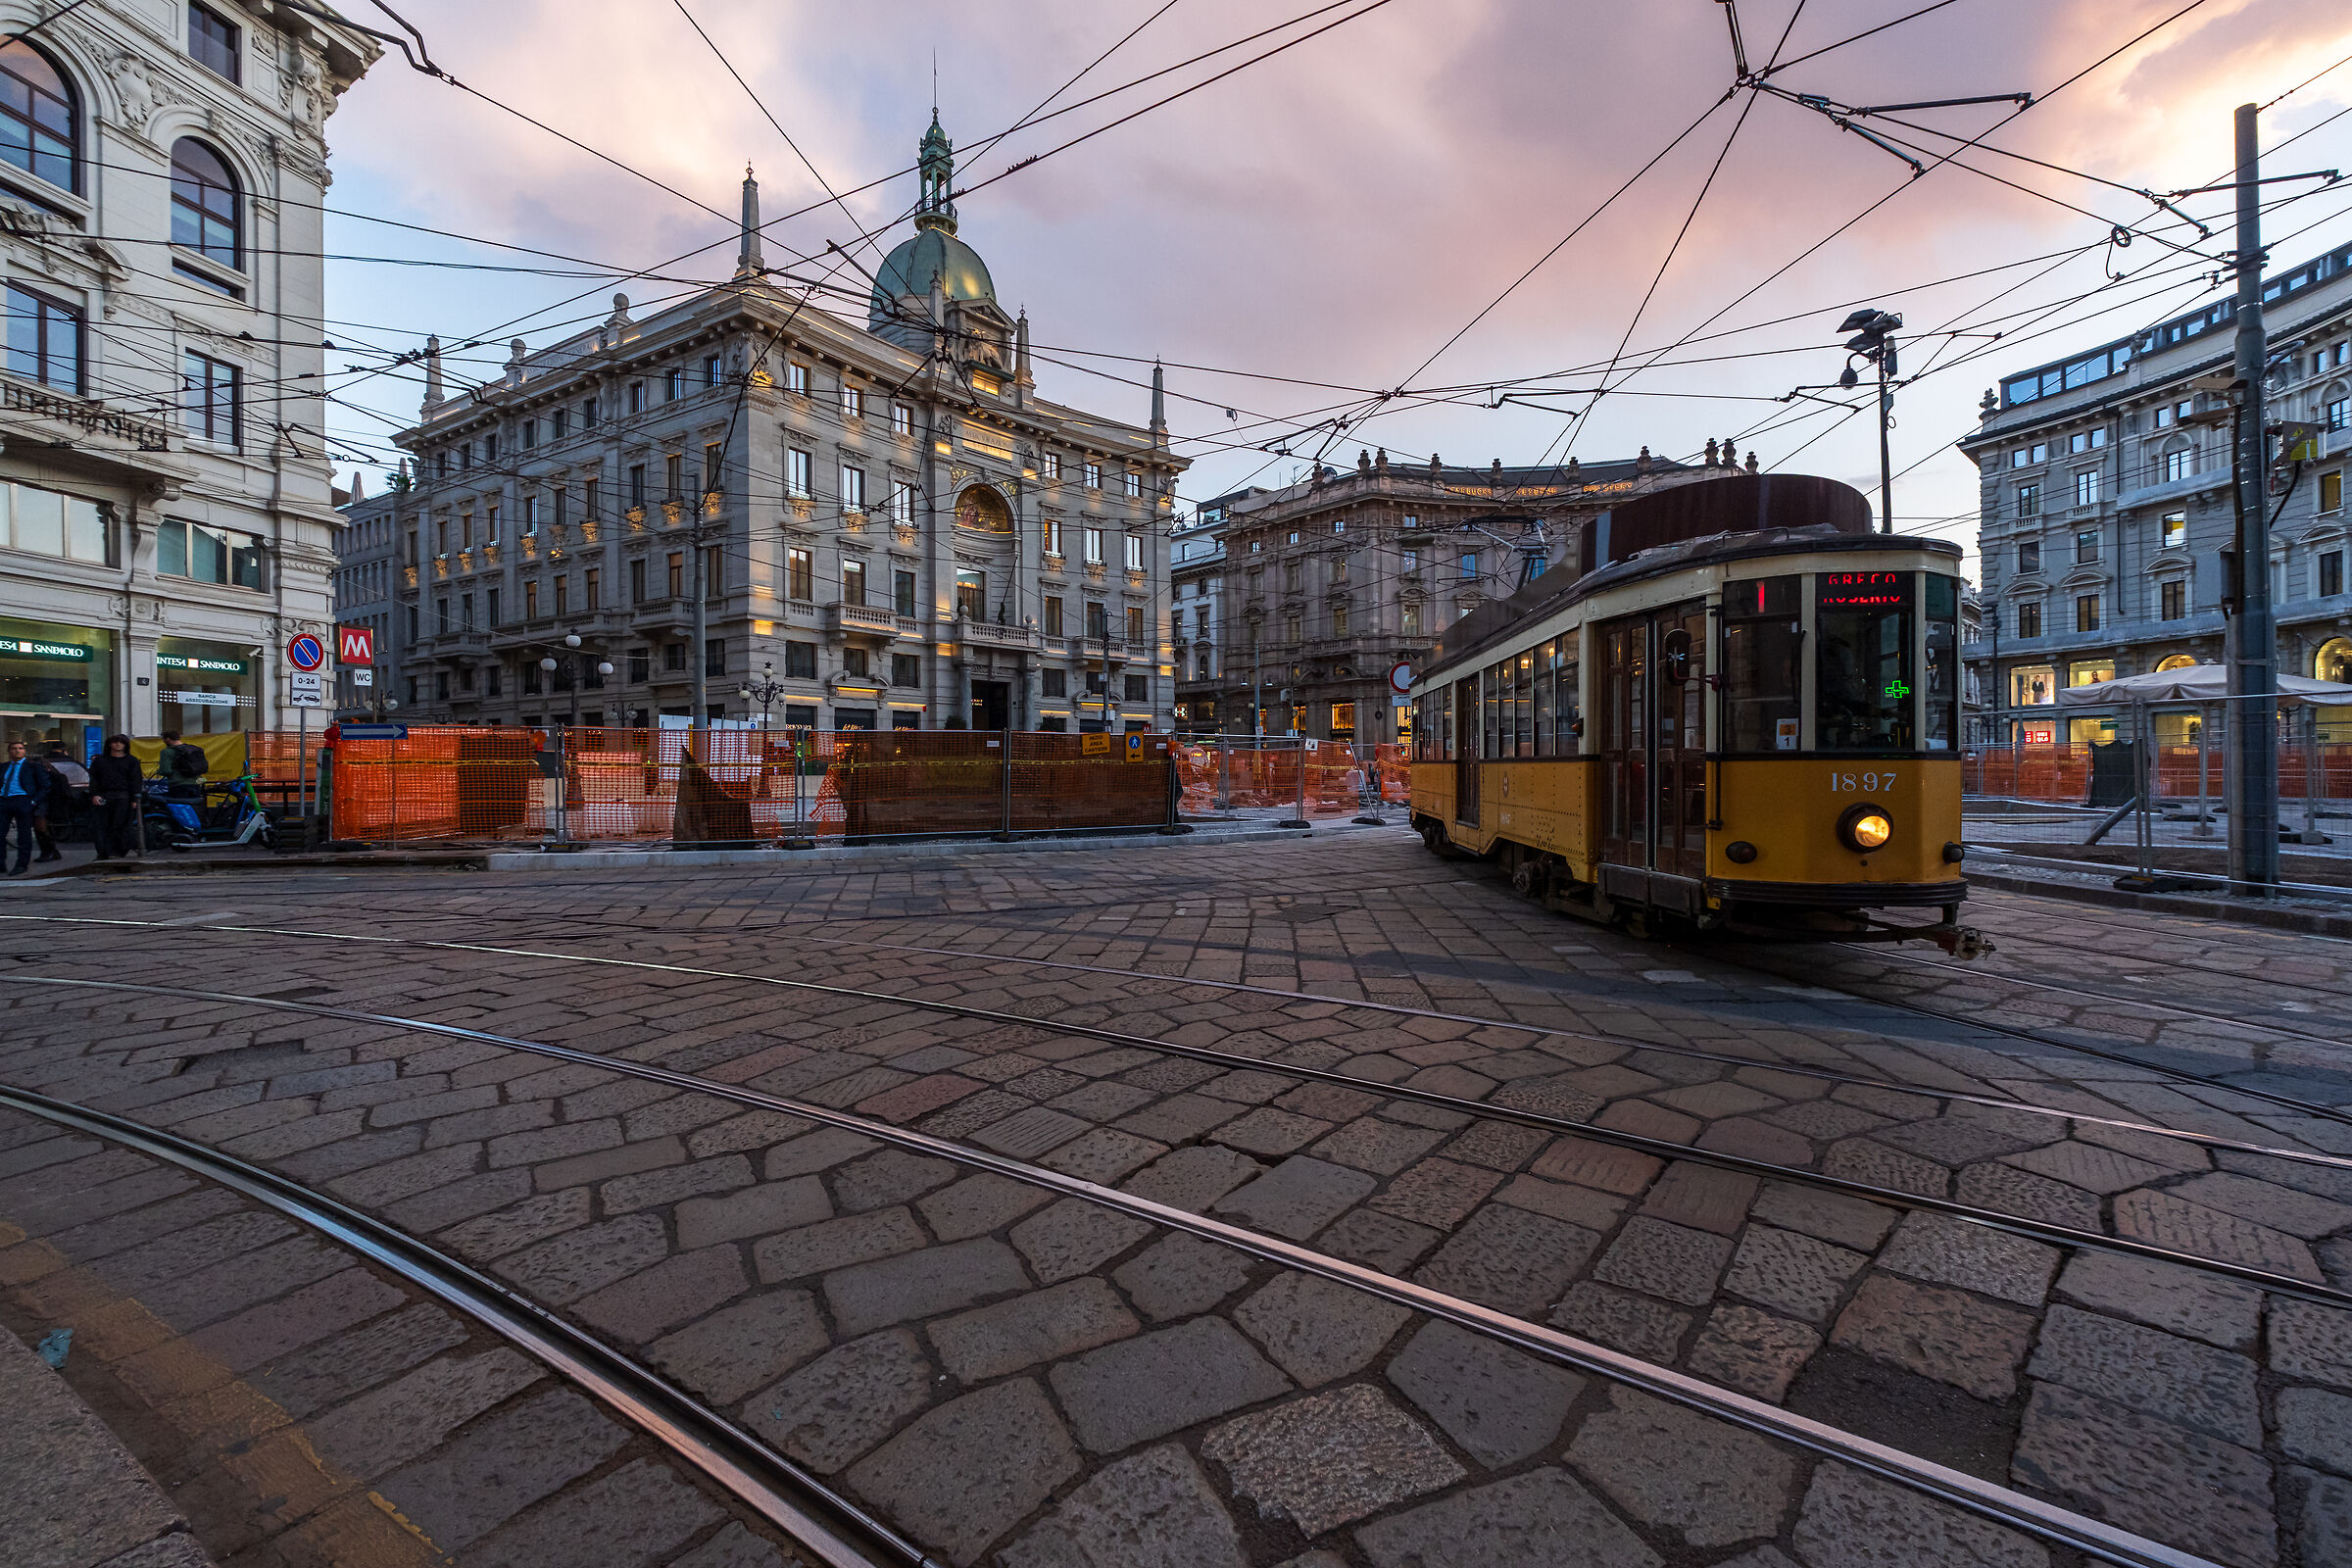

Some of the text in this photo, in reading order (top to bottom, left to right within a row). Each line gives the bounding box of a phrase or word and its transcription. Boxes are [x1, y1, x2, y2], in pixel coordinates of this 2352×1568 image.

[33, 643, 84, 658] SANPAOLO
[344, 634, 370, 659] M
[157, 656, 240, 671] INTESA SANPAOLO
[356, 672, 371, 682] WC
[1785, 724, 1792, 735] 3
[1784, 737, 1789, 747] 1
[1832, 772, 1896, 792] 1897
